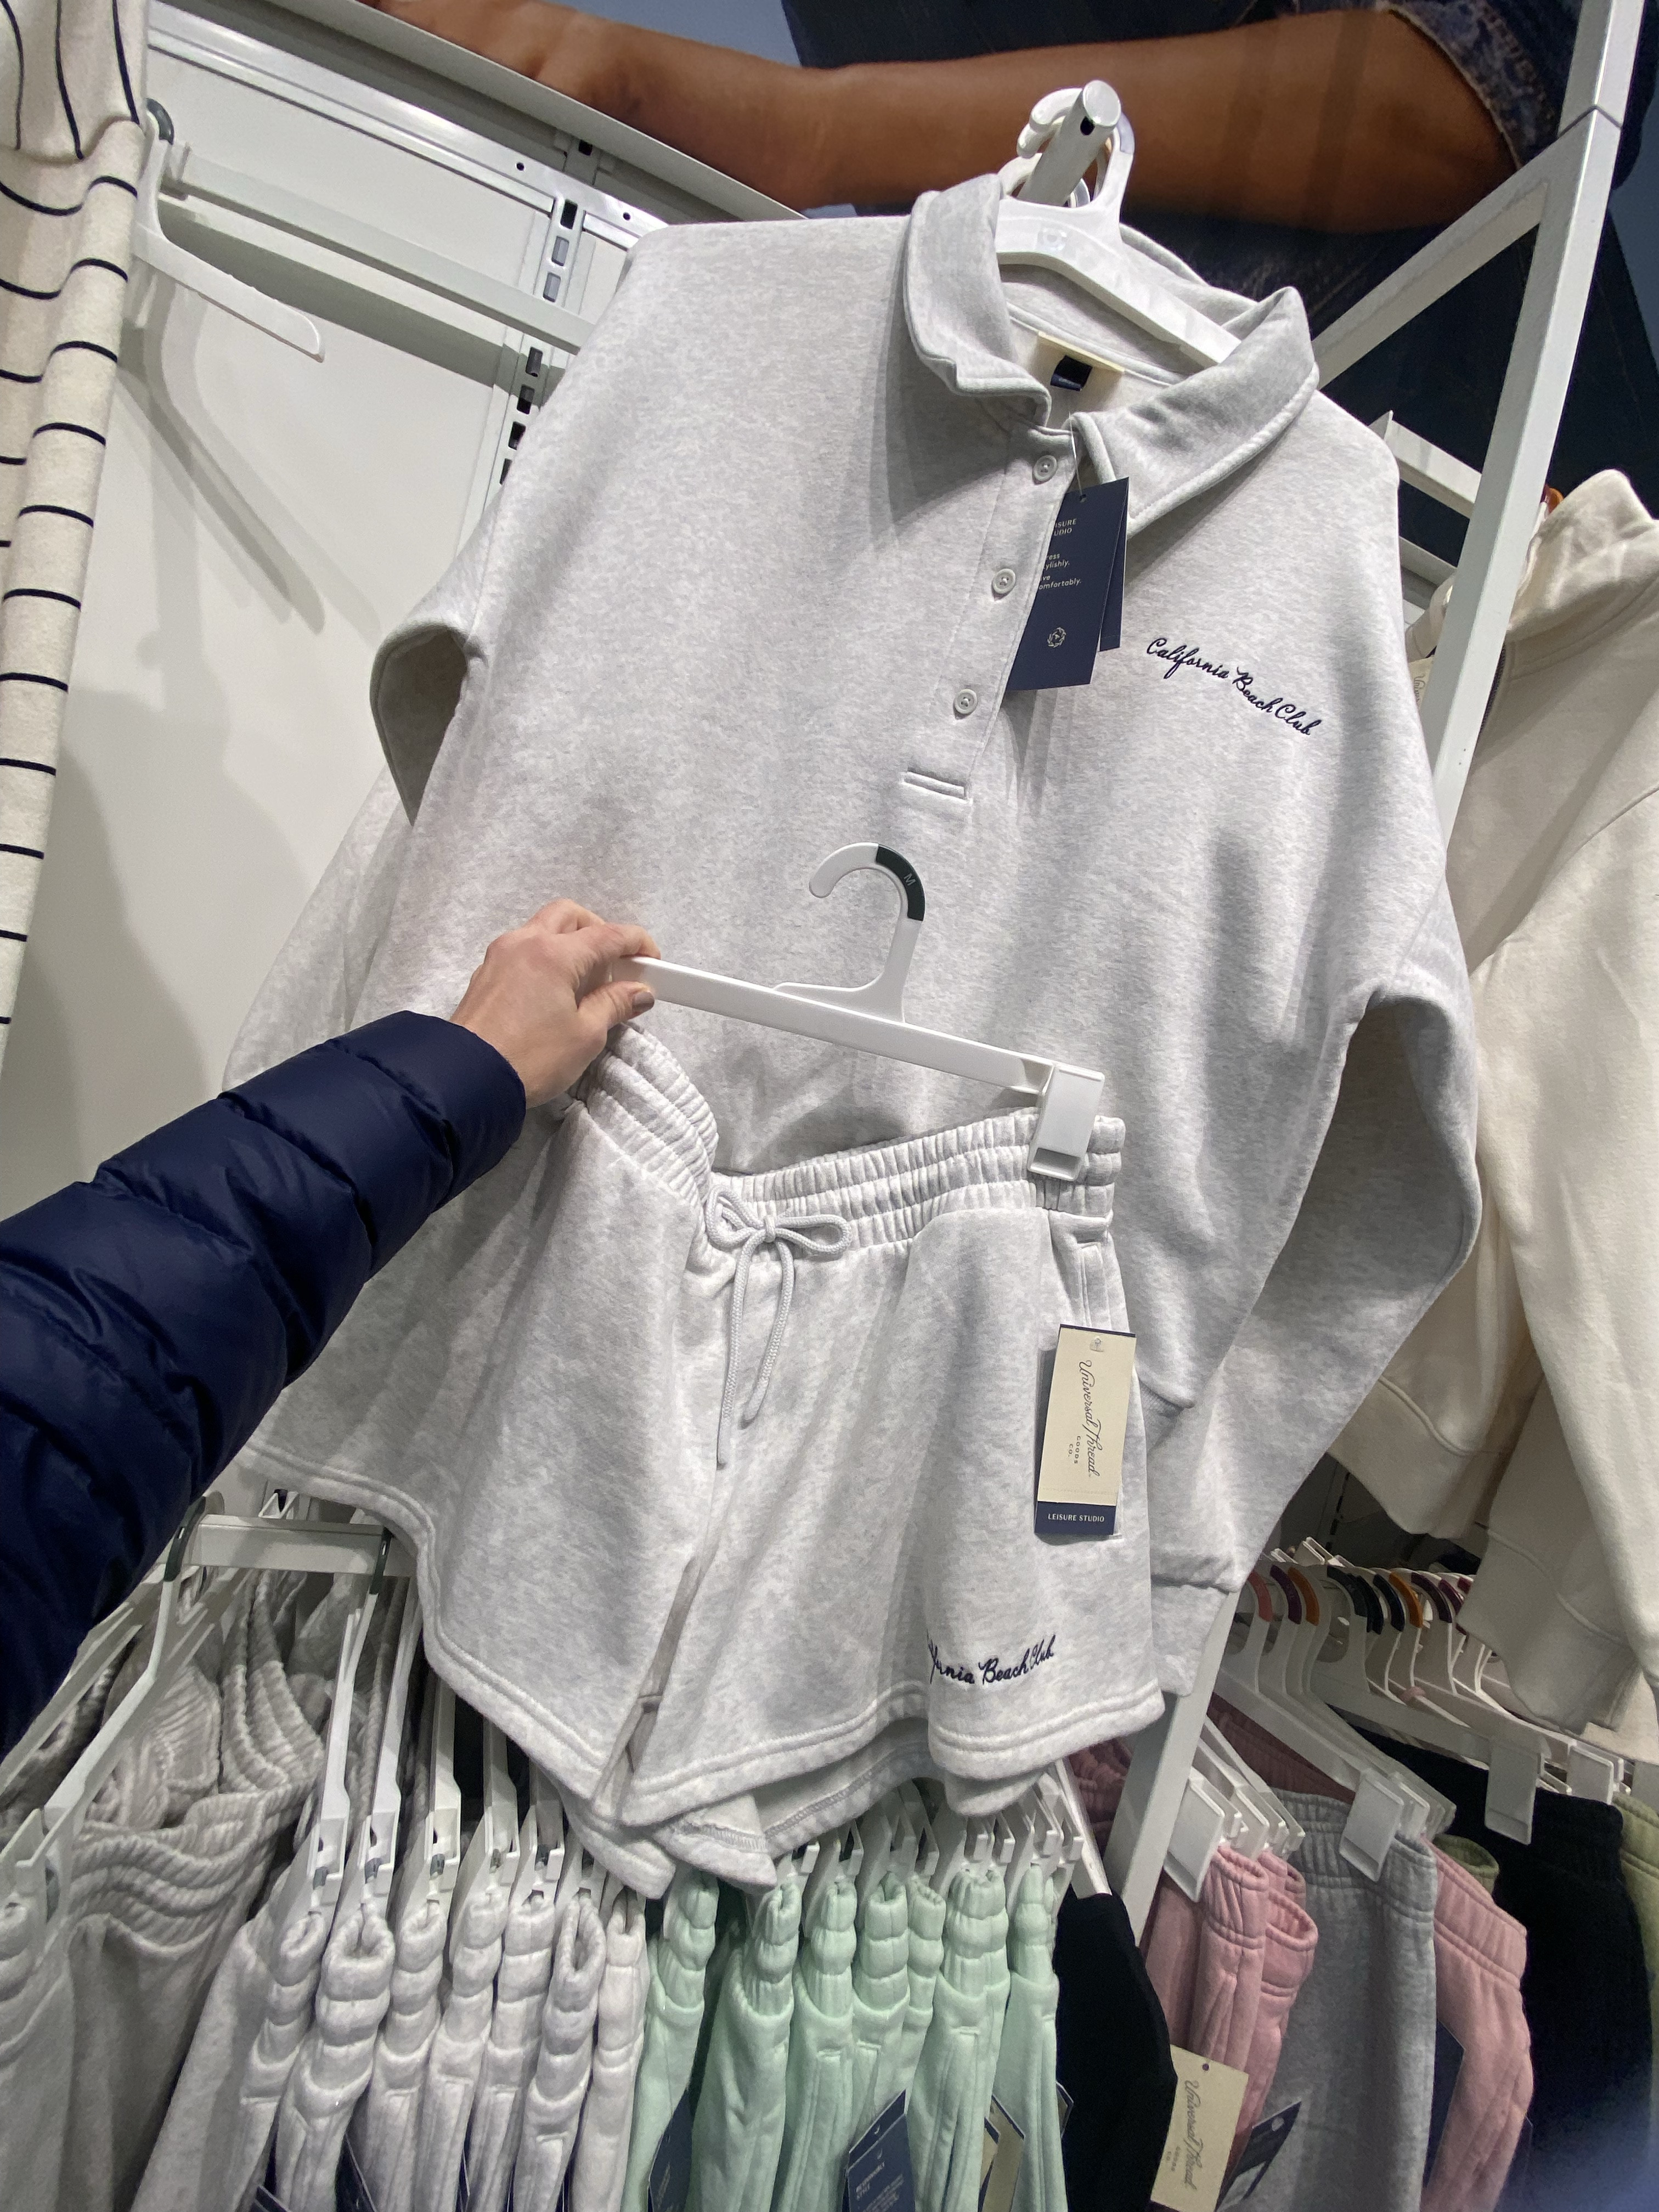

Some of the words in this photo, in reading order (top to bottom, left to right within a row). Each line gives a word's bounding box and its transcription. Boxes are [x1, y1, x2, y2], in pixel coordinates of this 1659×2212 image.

[1053, 528, 1073, 536] UDIO
[1054, 518, 1077, 528] ISURE
[1044, 560, 1070, 571] ylishly.
[1039, 578, 1081, 590] omfortably.
[1147, 637, 1229, 679] California
[1232, 667, 1283, 713] Beach
[1274, 704, 1322, 735] Club
[904, 873, 916, 886] M
[1079, 1360, 1098, 1427] Universal
[1082, 1419, 1103, 1477] Thread
[978, 1647, 1029, 1685] Beach
[1029, 1634, 1056, 1670] Club
[1184, 2080, 1201, 2147] Universal
